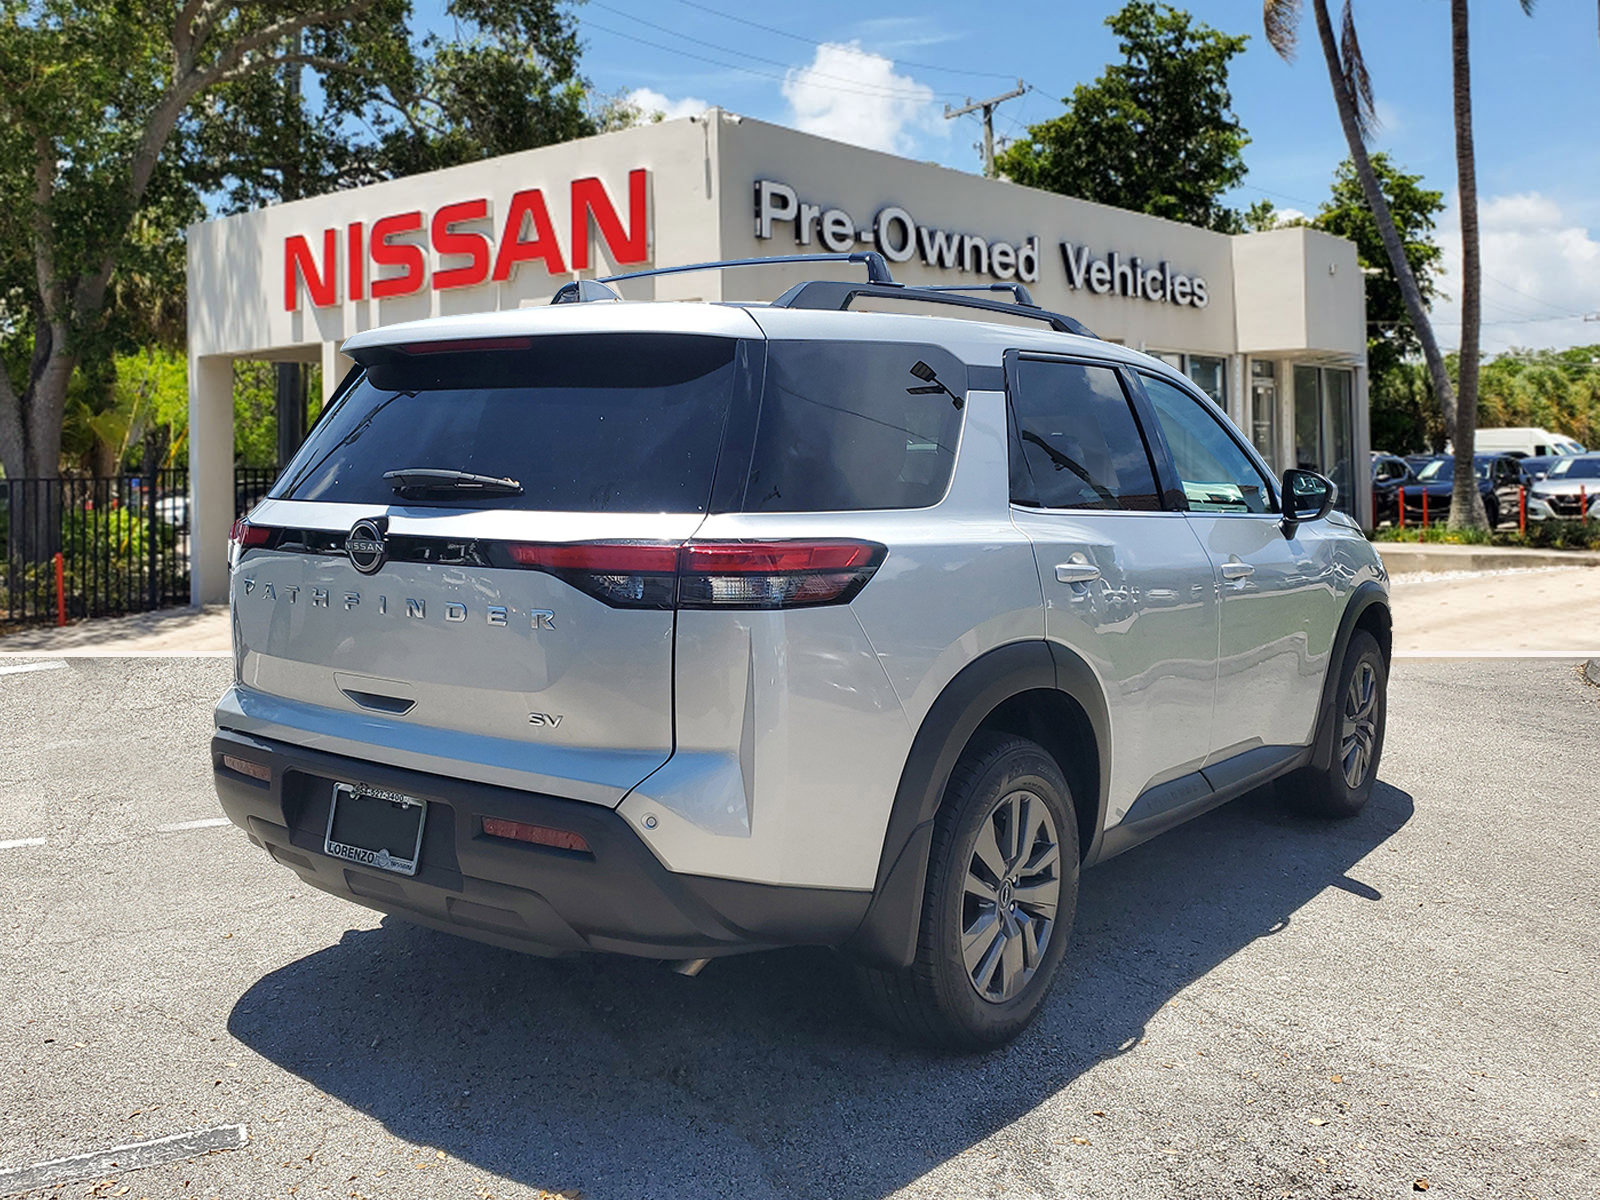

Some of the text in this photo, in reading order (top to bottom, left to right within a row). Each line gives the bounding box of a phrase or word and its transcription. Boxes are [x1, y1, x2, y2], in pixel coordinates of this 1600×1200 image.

[285, 168, 648, 312] NISSAN
[754, 179, 1209, 308] Pre-Owned Vehicles
[345, 541, 384, 552] NISSAN
[243, 577, 556, 631] PATHFINDER
[528, 711, 564, 729] SV
[328, 842, 375, 864] LORENZO
